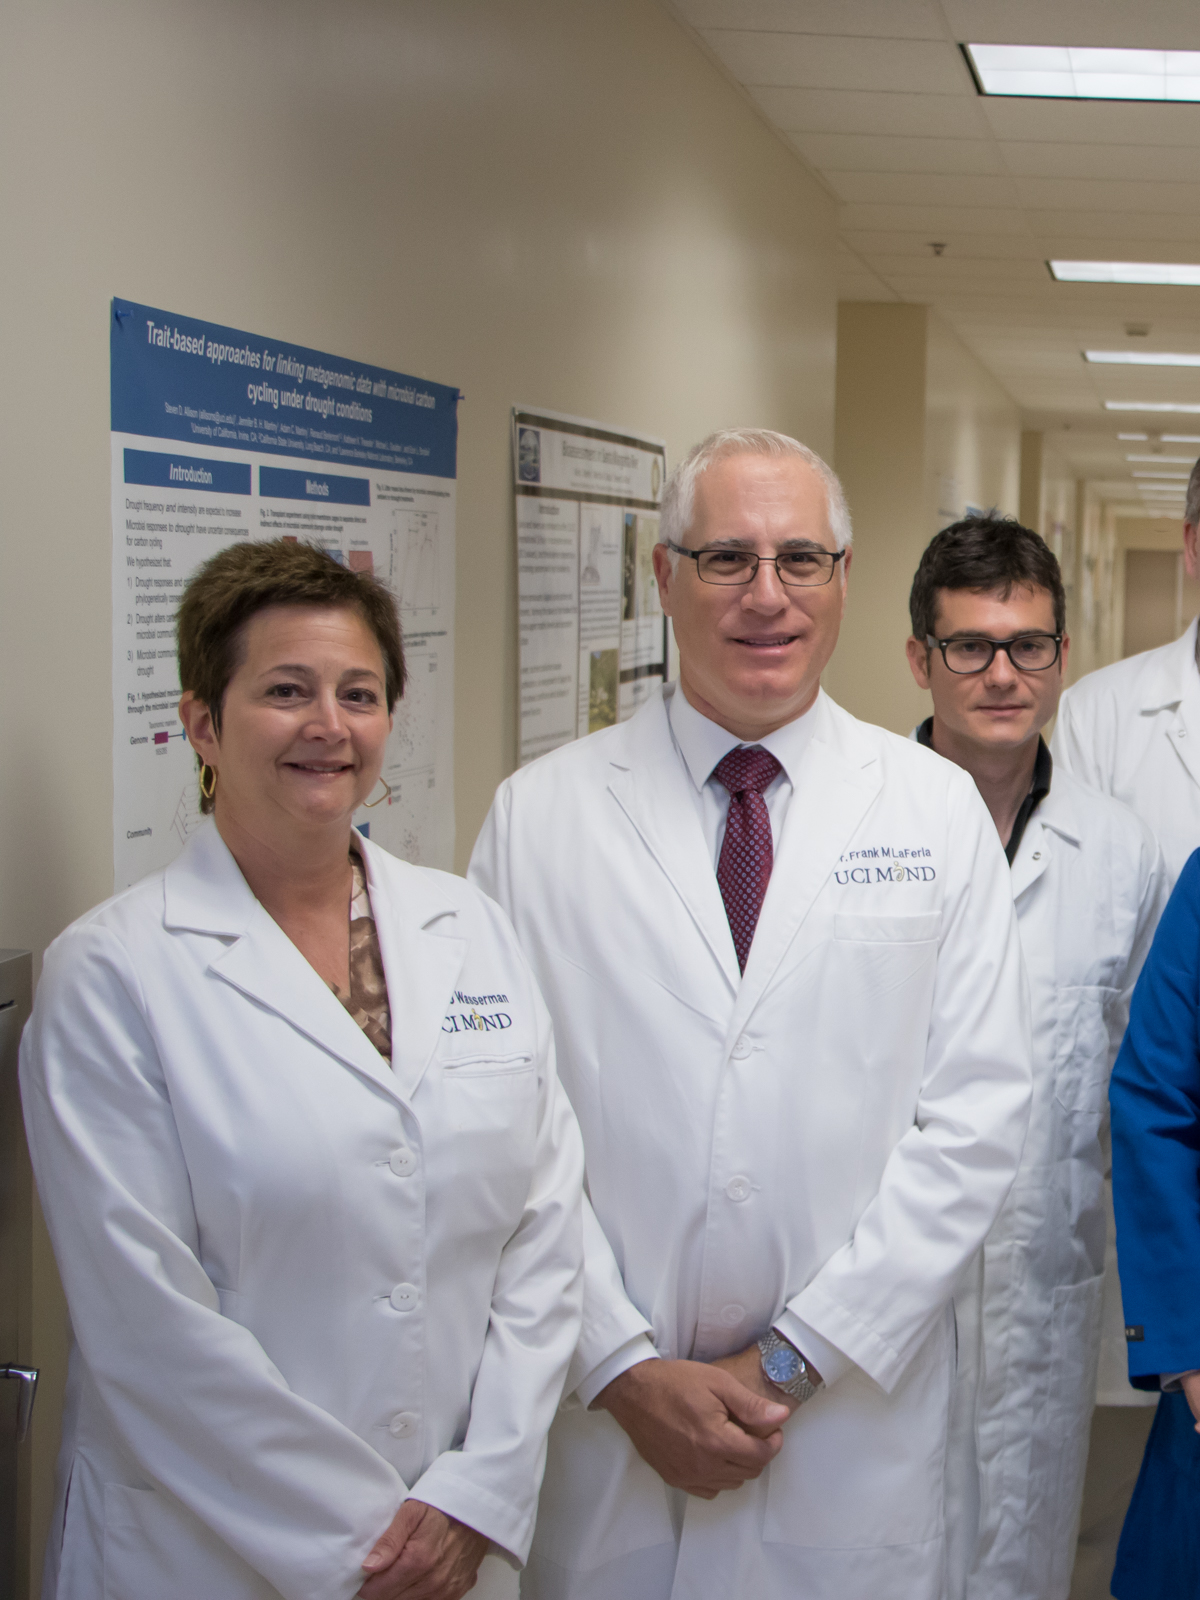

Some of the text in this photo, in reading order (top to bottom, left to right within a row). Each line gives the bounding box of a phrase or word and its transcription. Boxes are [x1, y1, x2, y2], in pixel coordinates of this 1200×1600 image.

[146, 320, 205, 356] Trait-based
[206, 341, 261, 369] approaches
[262, 349, 276, 371] for
[276, 353, 304, 383] linking
[305, 365, 356, 391] metagenomic
[356, 374, 372, 394] data
[247, 382, 372, 423] cycling under drought conditions
[169, 463, 213, 484] Introduction
[305, 479, 329, 496] Methods
[125, 498, 143, 513] Drought
[165, 502, 177, 513] and
[130, 735, 149, 745] Genome
[126, 826, 153, 840] Community
[849, 847, 879, 860] Frank
[881, 846, 891, 858] M
[834, 867, 872, 885] UCI
[454, 990, 509, 1006] Wasserman
